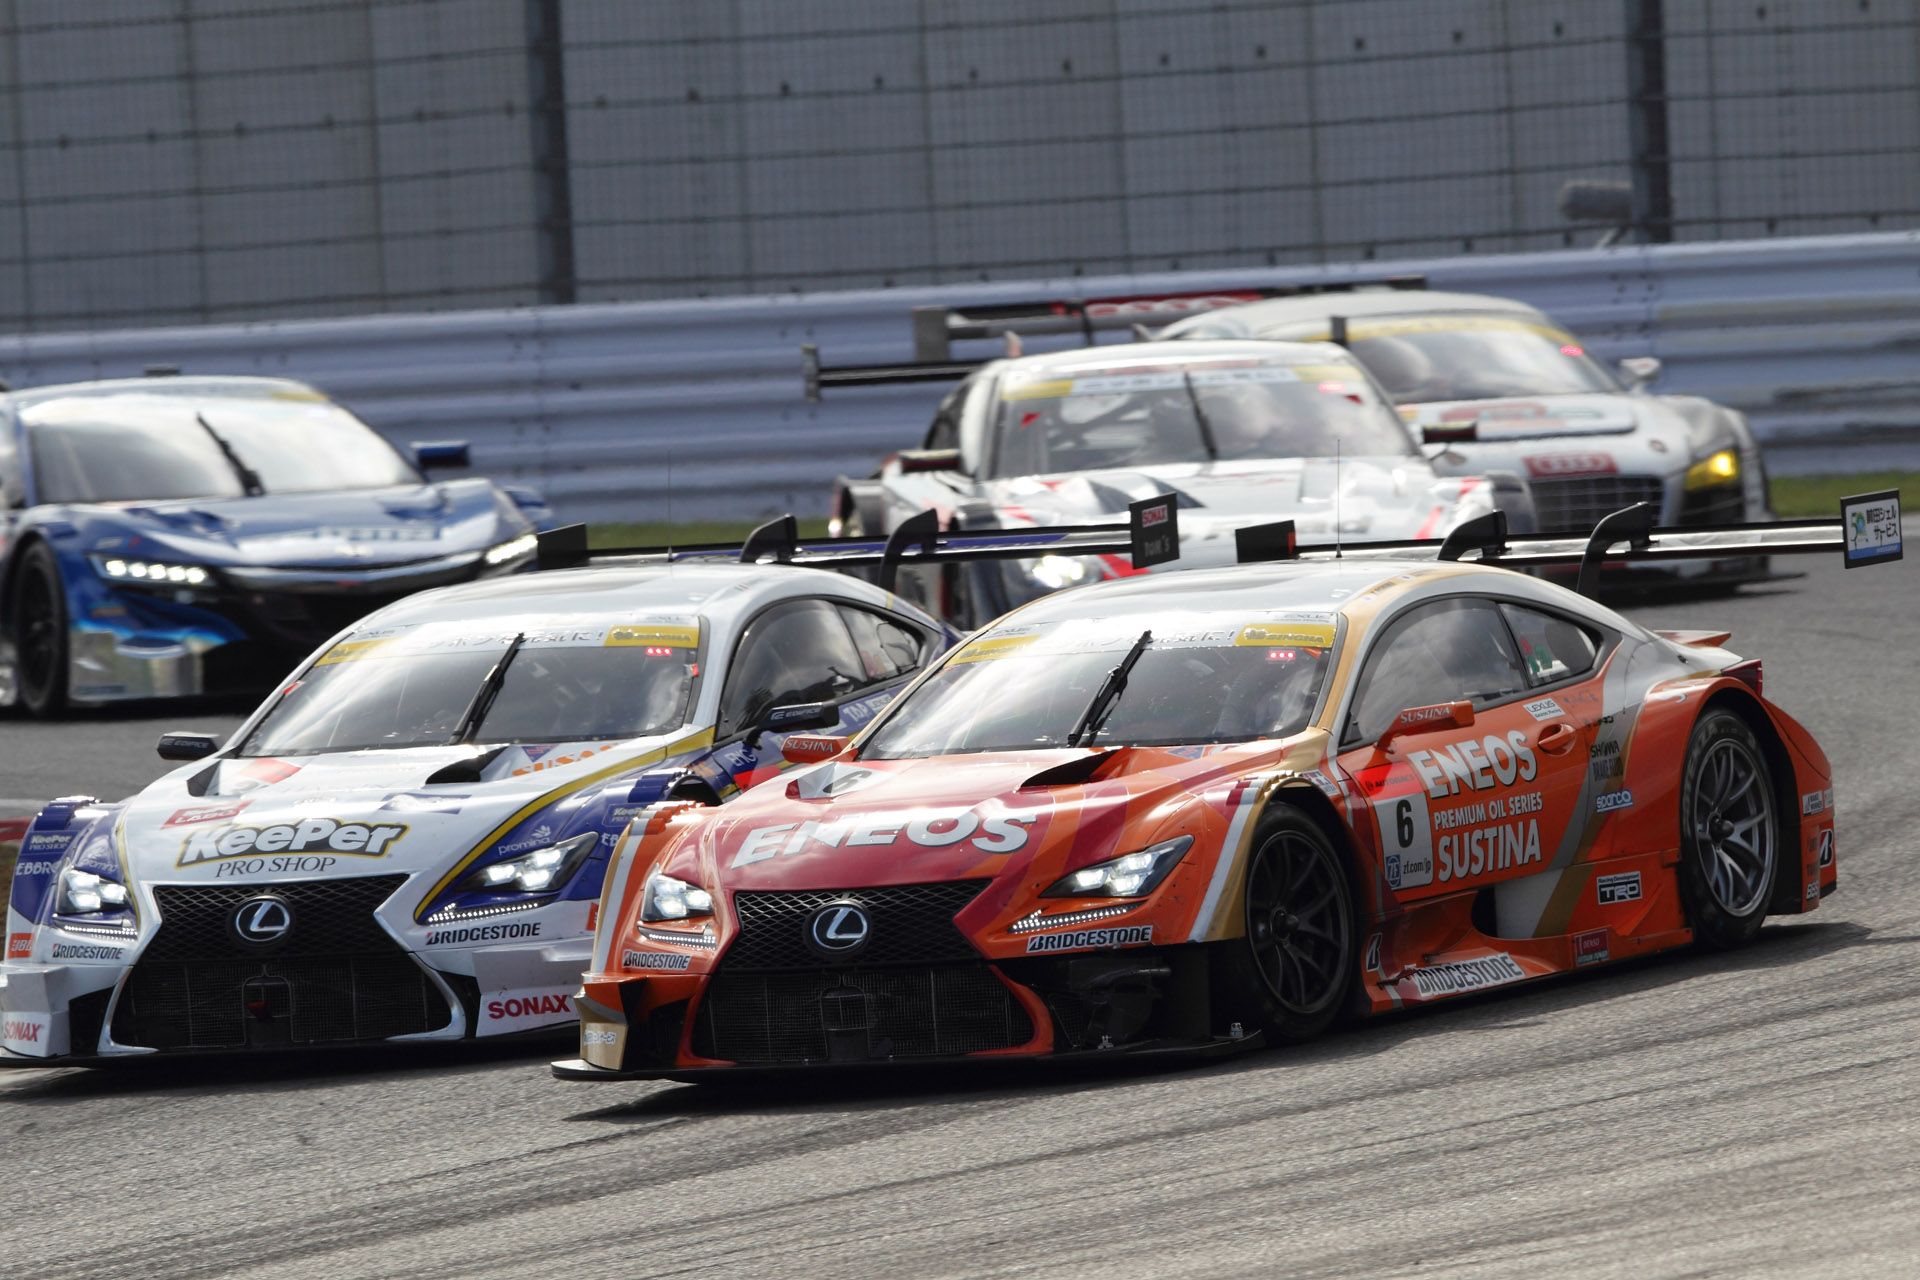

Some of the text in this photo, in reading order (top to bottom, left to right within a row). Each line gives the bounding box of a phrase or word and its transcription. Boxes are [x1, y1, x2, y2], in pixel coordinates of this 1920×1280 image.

[1400, 707, 1450, 723] SUSTINA
[1527, 700, 1556, 713] LEXUS
[785, 739, 833, 752] SUSTINA
[1406, 730, 1537, 798] ENEOS
[1596, 791, 1632, 809] sparco
[612, 807, 641, 818] KeeP
[1434, 792, 1543, 830] PREMIUM OIL SERIES
[1396, 800, 1414, 848] 6
[31, 835, 71, 846] KeePer
[178, 818, 408, 866] KeePer
[498, 838, 551, 855] promina
[731, 806, 1038, 869] ENEOS
[1438, 818, 1542, 882] SUSTINA
[216, 856, 336, 878] PRO SHOP
[1387, 863, 1399, 878] ZF
[1403, 858, 1431, 874] zf.com/jp
[1601, 883, 1639, 900] TRD
[426, 922, 541, 945] BRIDGESTONE
[1029, 927, 1151, 951] BRIDGESTONE
[53, 943, 123, 959] BRIDGESTONE
[623, 951, 690, 968] BRIDGESTONE
[1418, 955, 1521, 994] BRIDGESTONE
[488, 995, 570, 1019] SONAX
[4, 1021, 42, 1042] SONAX
